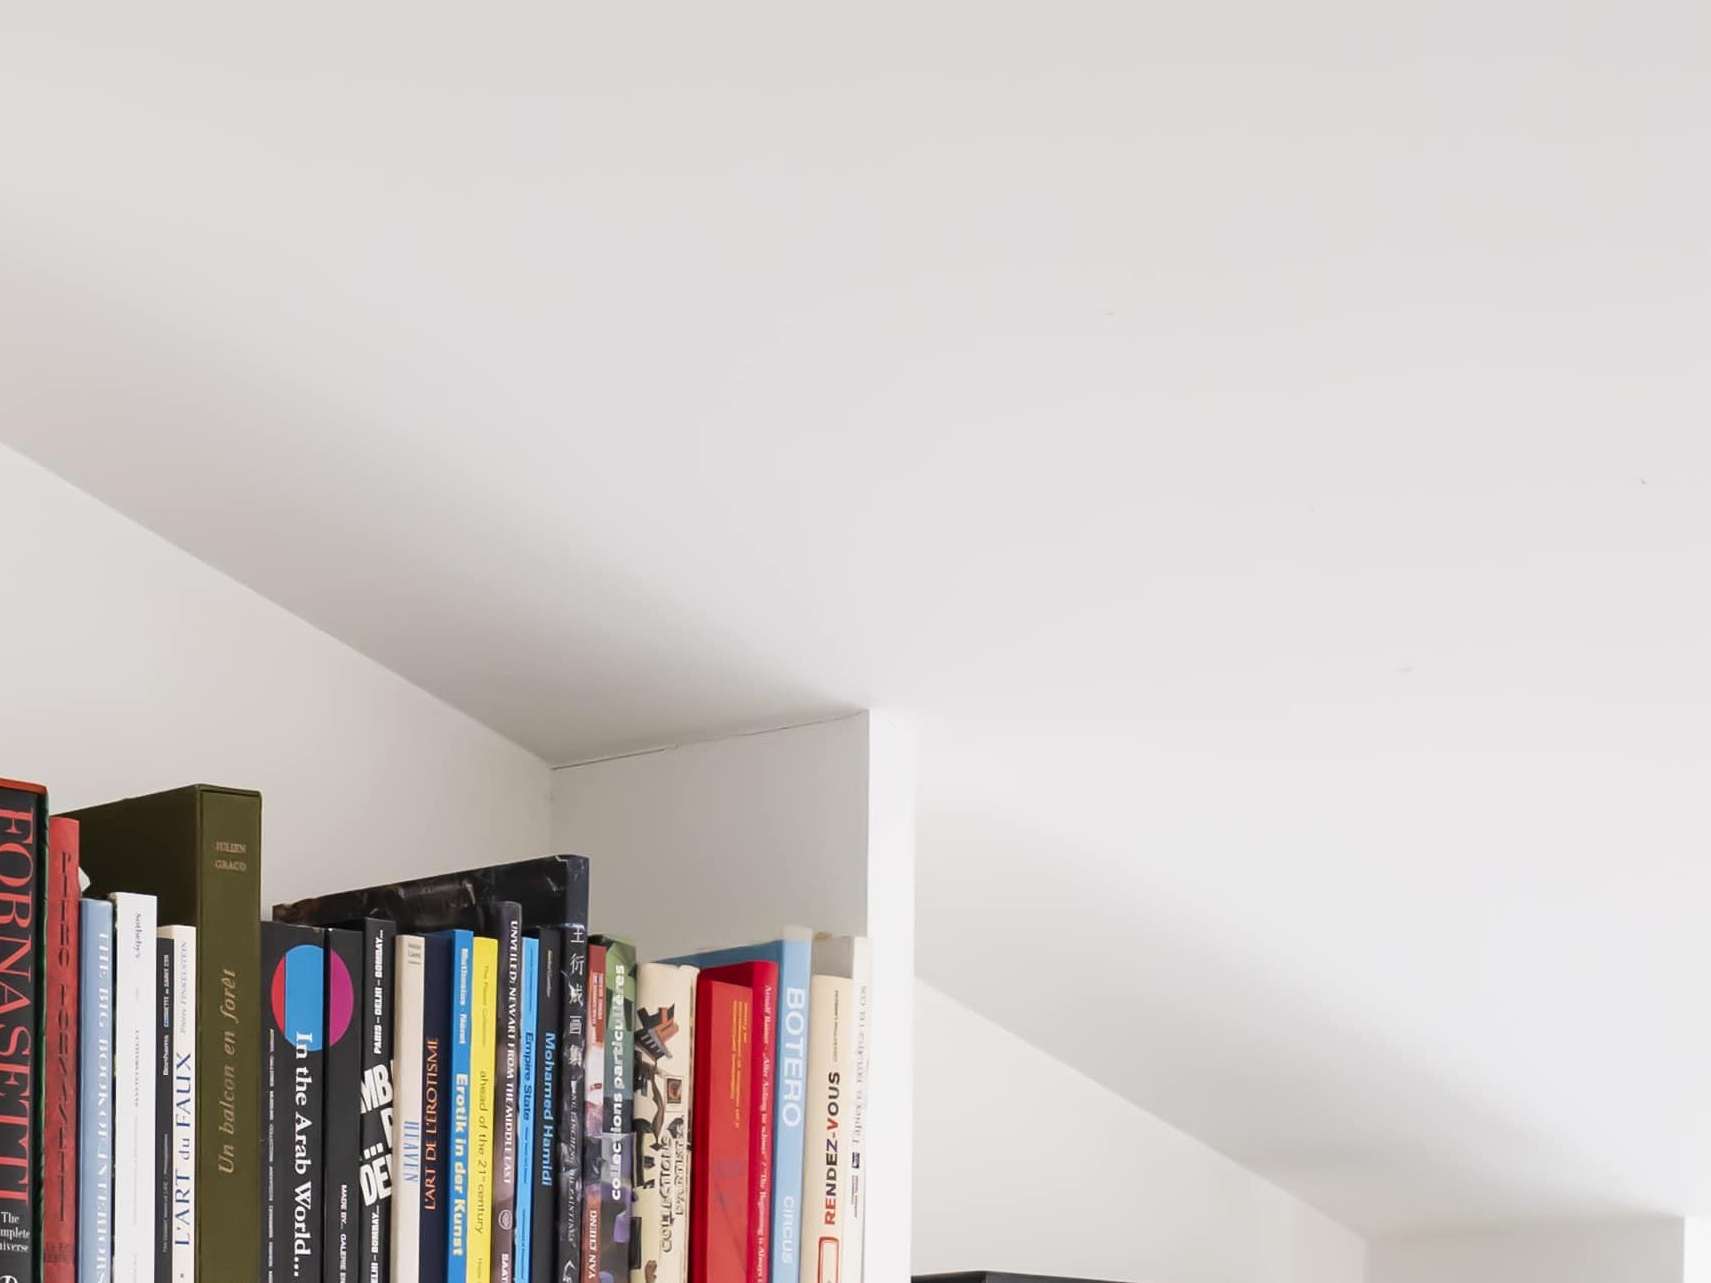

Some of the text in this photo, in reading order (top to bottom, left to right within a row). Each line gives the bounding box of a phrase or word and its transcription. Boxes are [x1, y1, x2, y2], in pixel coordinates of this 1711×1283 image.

[217, 968, 240, 1174] Un balcon en forêt
[295, 1031, 312, 1062] In
[295, 1067, 312, 1107] the
[781, 985, 806, 1128] BOTERO
[174, 1051, 192, 1246] L'ART du FAUX
[294, 1115, 312, 1174] Arab
[452, 1073, 468, 1256] Erotik in der Kunst
[540, 1033, 556, 1187] Mohamed Hamidi
[823, 1071, 840, 1226] RENDEZ-VOUS
[0, 1210, 20, 1224] The
[294, 1182, 312, 1277] World...
[780, 1196, 795, 1265] CIRCUS
